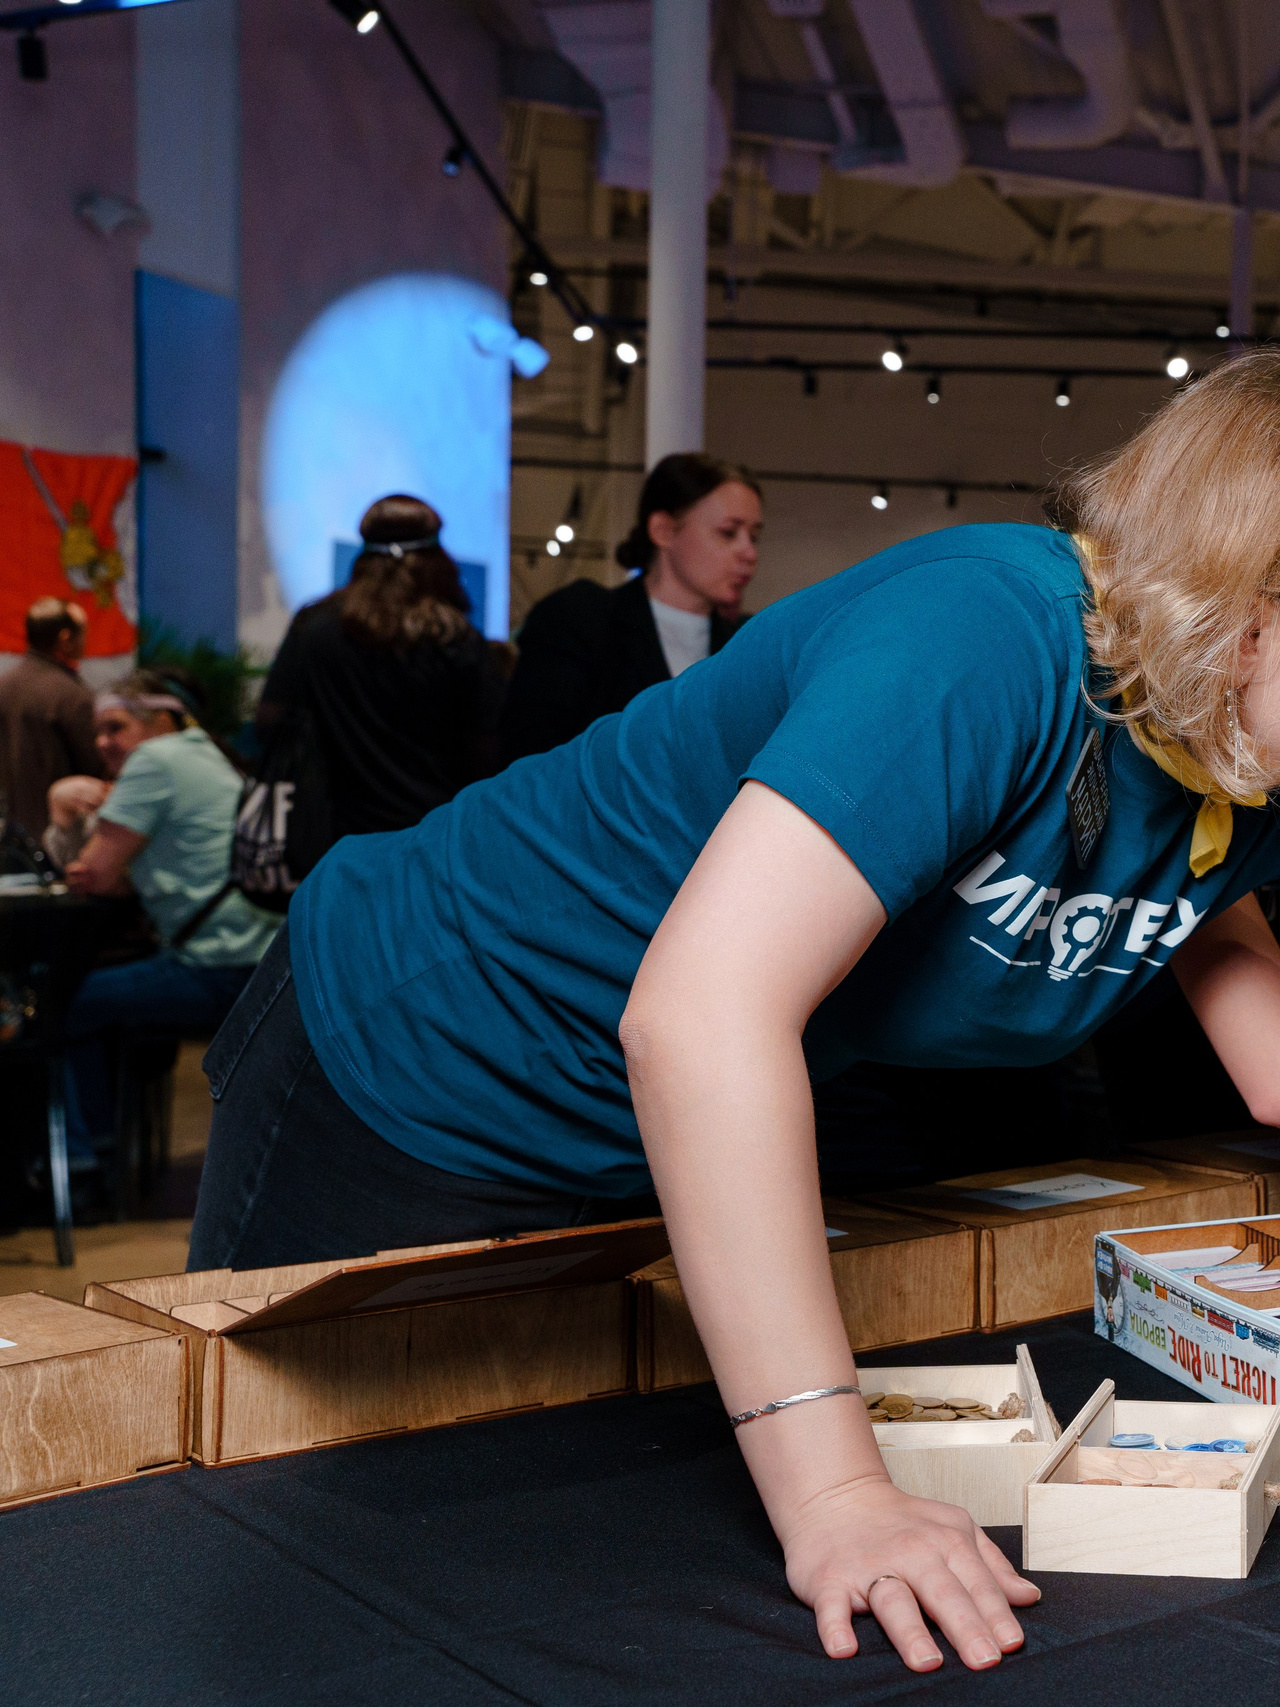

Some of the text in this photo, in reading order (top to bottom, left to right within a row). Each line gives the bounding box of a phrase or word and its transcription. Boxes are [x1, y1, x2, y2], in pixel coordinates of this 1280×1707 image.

[1129, 1309, 1166, 1351] ЕВРОПА
[1168, 1325, 1203, 1385] RIDE
[1205, 1351, 1218, 1380] TO
